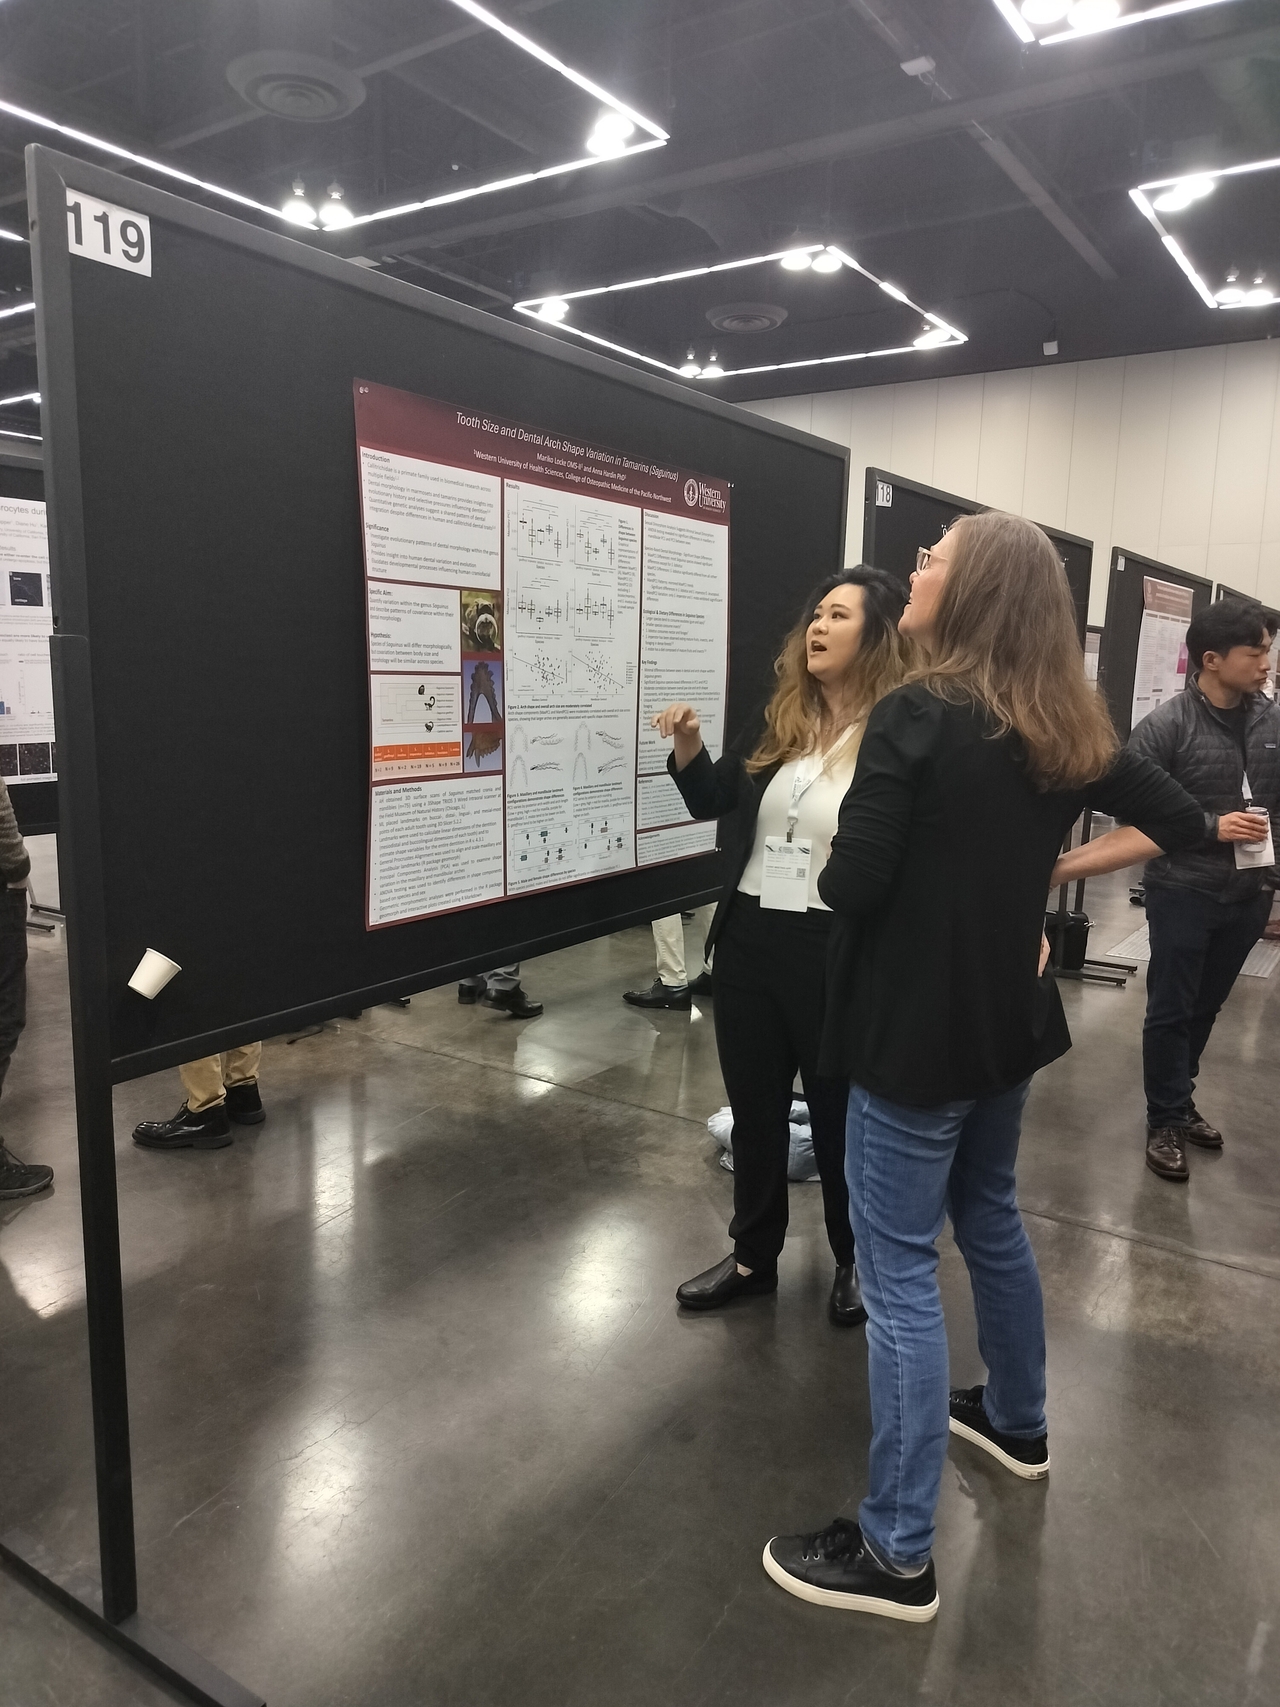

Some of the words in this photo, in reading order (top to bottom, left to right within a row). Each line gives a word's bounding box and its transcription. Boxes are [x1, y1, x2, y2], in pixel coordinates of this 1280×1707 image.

[66, 201, 145, 264] 119
[362, 452, 390, 463] Introduction
[457, 412, 481, 429] Tooth
[482, 418, 500, 434] Size
[501, 424, 516, 439] and
[518, 428, 543, 446] Dental
[544, 436, 561, 450] Arch
[562, 441, 584, 459] Shape
[586, 447, 614, 464] Variation
[615, 455, 621, 466] in
[622, 457, 649, 474] Tamarins
[649, 465, 679, 483] (Saguinus)
[498, 455, 522, 470] University
[523, 461, 529, 470] of
[529, 463, 544, 474] Health
[544, 467, 565, 480] Sciences,
[565, 472, 581, 484] College
[582, 476, 587, 484] of
[587, 477, 611, 491] Osteopathic
[611, 483, 629, 493] Medicine
[698, 482, 721, 500] Western
[876, 484, 891, 503] 118
[698, 493, 727, 514] University
[366, 523, 389, 533] Significance
